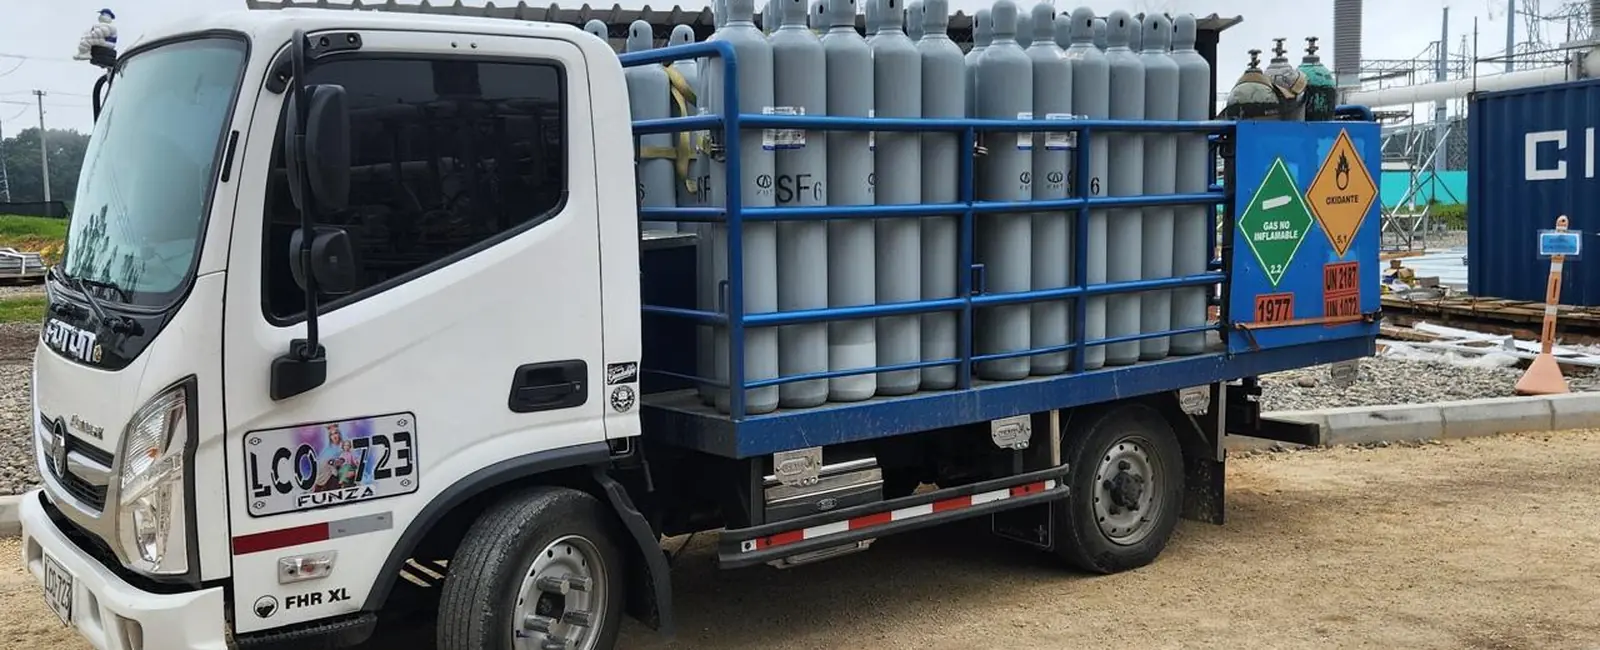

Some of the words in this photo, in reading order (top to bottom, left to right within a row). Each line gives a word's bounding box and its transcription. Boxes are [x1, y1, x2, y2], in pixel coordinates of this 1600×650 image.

[1325, 194, 1359, 205] OXIDANTE
[1263, 221, 1278, 231] GAS
[1279, 220, 1290, 230] NO
[1253, 230, 1299, 241] INFLAMABLE
[1336, 234, 1348, 244] 5.1
[1270, 264, 1282, 274] 2.2
[1326, 267, 1338, 291] UN
[1339, 265, 1357, 289] 2187
[1259, 298, 1290, 322] 1977
[1326, 299, 1338, 317] UN
[250, 443, 317, 498] LCO
[353, 431, 413, 482] 723
[297, 486, 374, 507] FUNZA
[285, 592, 323, 610] FHR
[328, 587, 351, 603] XL
